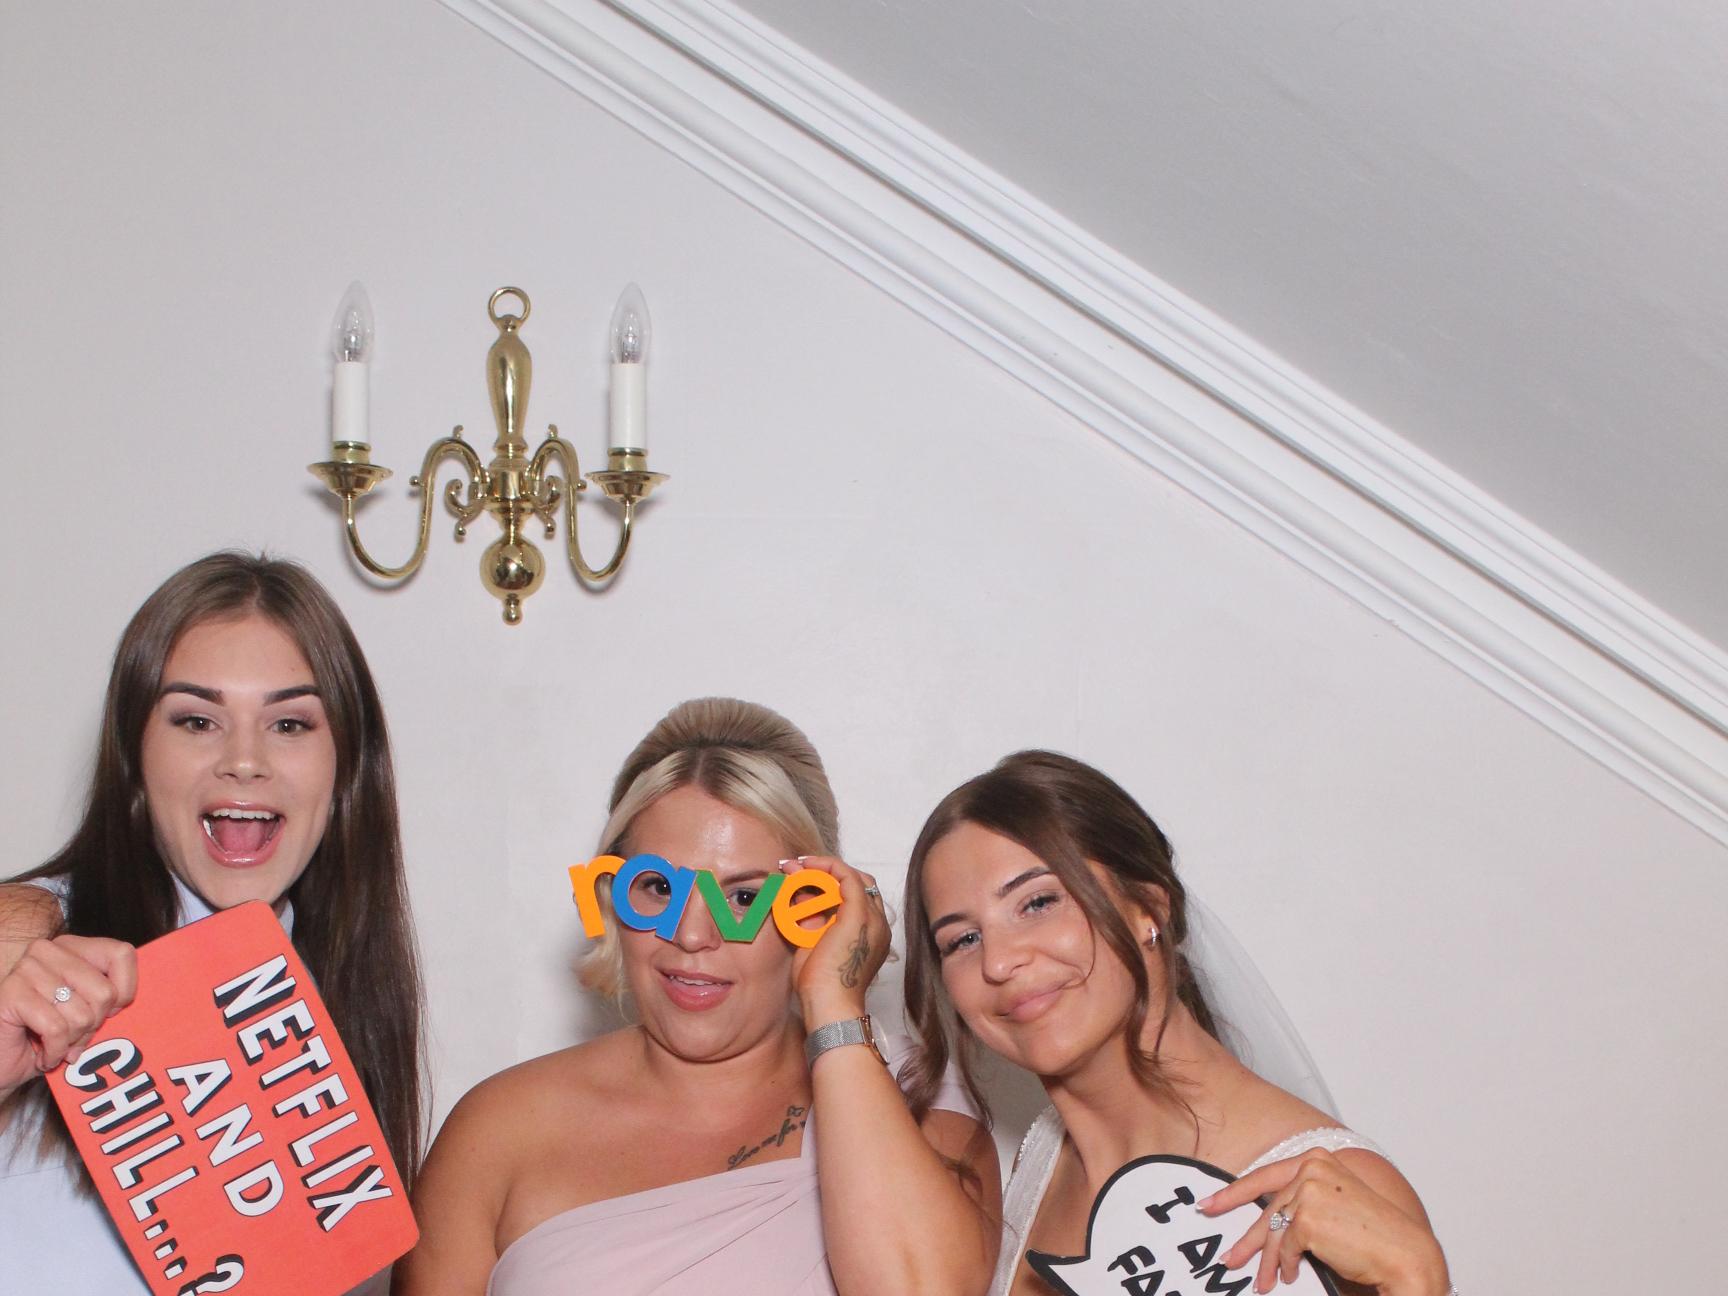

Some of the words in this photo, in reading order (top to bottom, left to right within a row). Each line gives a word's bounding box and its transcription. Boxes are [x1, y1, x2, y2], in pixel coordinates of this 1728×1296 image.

[568, 853, 843, 949] rave
[166, 1058, 285, 1217] AND
[213, 954, 394, 1233] NETFLIX
[1145, 1186, 1195, 1224] I
